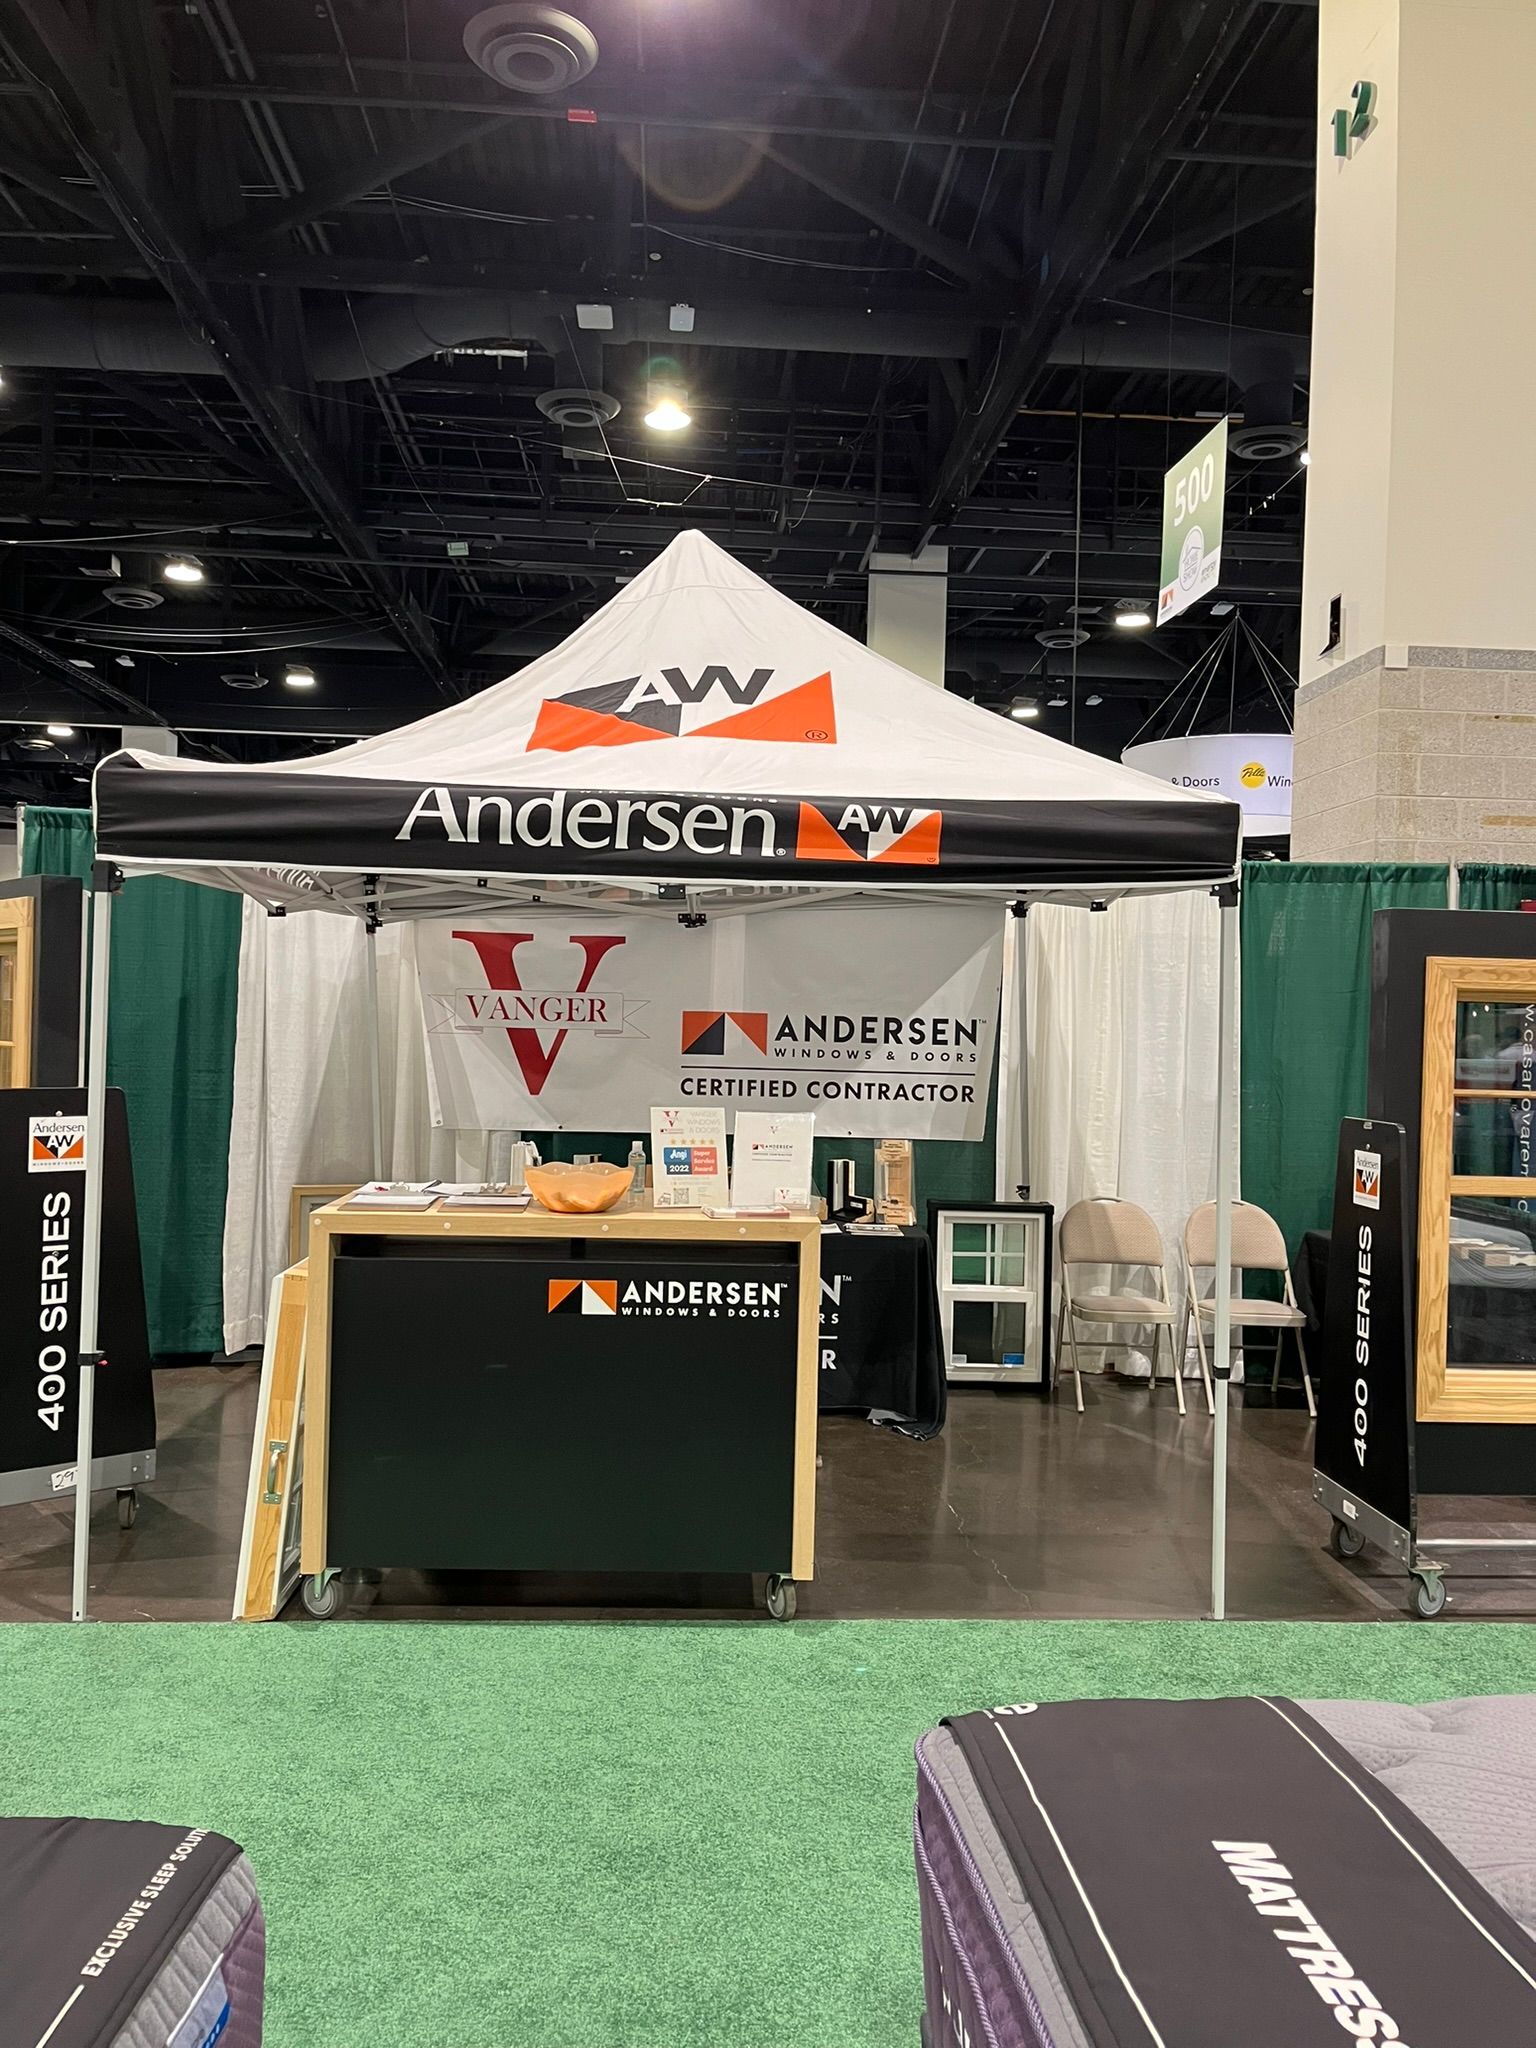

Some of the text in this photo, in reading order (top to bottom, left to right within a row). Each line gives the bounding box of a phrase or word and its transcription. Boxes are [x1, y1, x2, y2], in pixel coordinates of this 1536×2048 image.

[1330, 80, 1371, 156] 12
[1174, 453, 1214, 527] 500
[1182, 776, 1220, 787] Doors
[1267, 775, 1293, 787] Win
[395, 787, 776, 858] Andersen
[466, 995, 608, 1023] VANGER
[774, 1047, 977, 1063] WINDOWS & DOORS
[680, 1077, 976, 1103] CERTIFIED CONTRACTOR
[33, 1123, 85, 1133] Andersen
[670, 1149, 688, 1160] Angi
[669, 1164, 690, 1173] 2022
[37, 1191, 71, 1431] 400 SERIES
[622, 1307, 781, 1318] WINDOWS & DOORS
[1354, 1225, 1372, 1467] 400 SERIES
[81, 1900, 152, 1977] EXCLUSIVE
[140, 1862, 179, 1899] SLEEP
[1211, 1840, 1410, 2048] MATTRES
